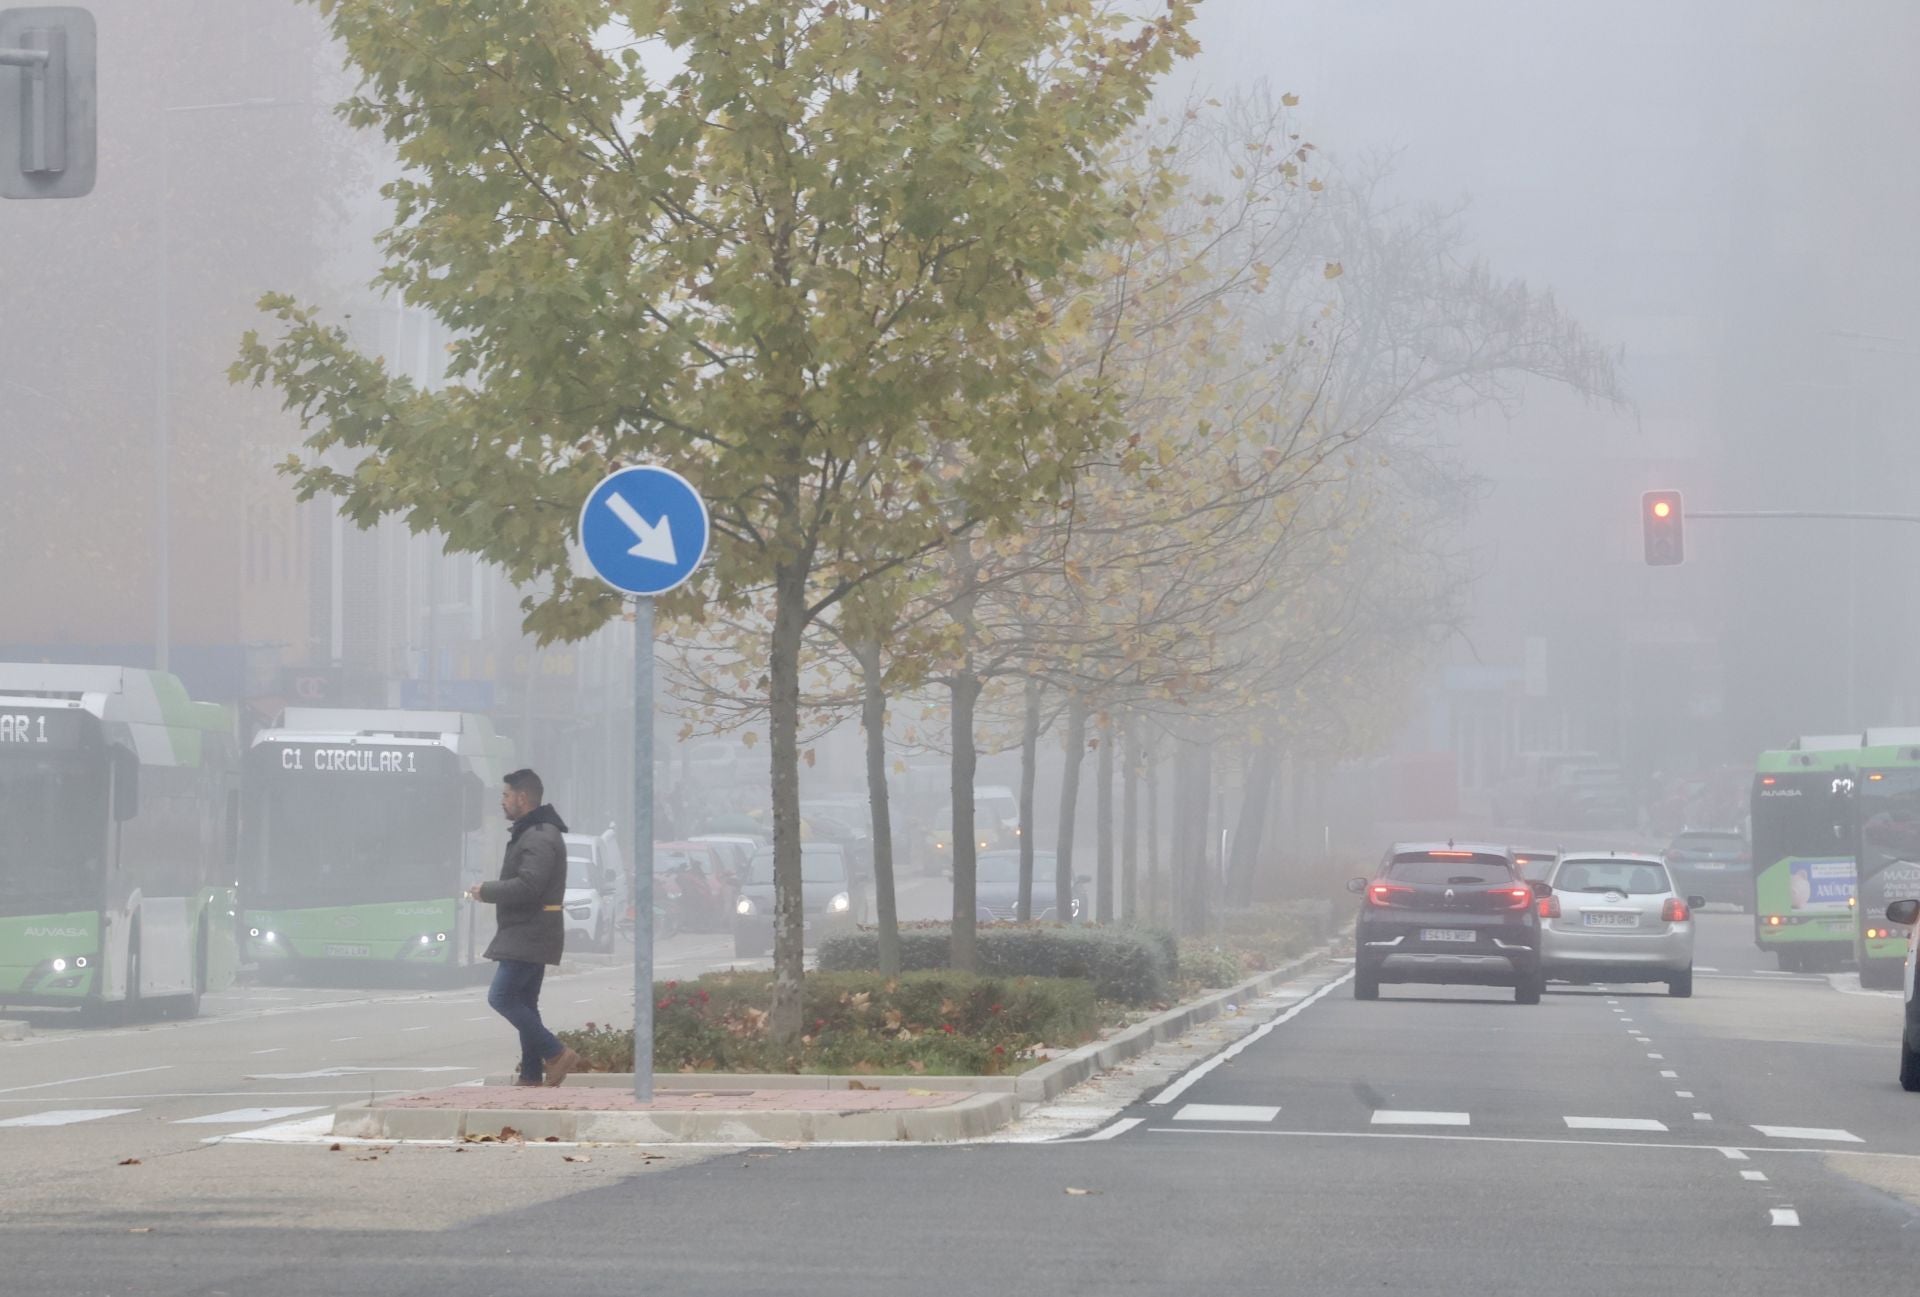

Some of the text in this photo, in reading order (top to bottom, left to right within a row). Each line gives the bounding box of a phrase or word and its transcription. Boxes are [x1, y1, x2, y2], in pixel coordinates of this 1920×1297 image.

[36, 715, 48, 743] 1
[281, 748, 417, 773] C1 CIRCULAR 1
[24, 926, 88, 937] AUVASA
